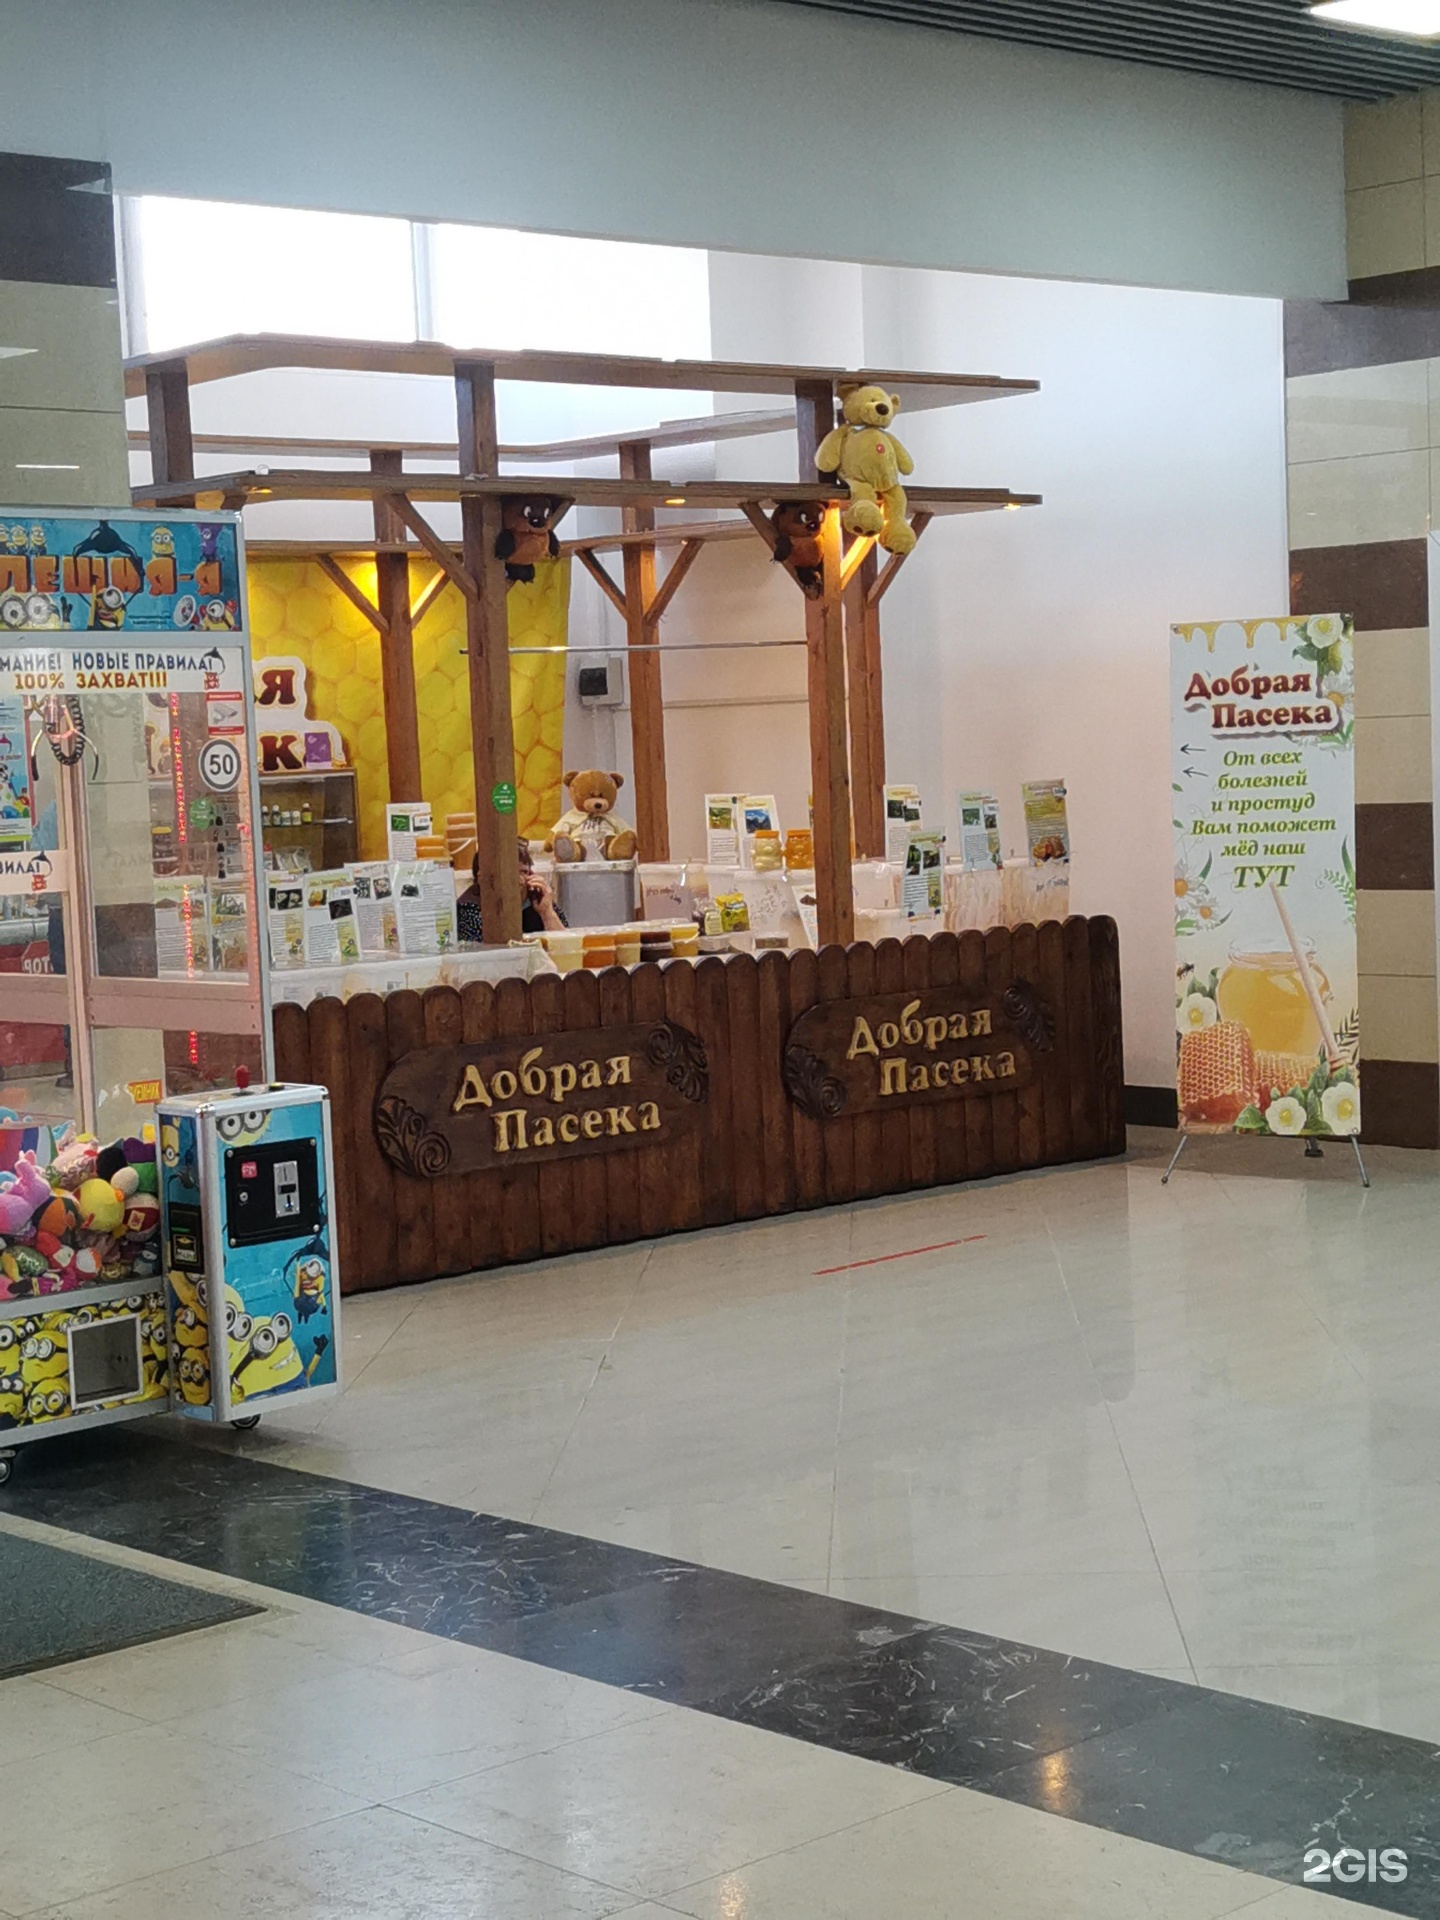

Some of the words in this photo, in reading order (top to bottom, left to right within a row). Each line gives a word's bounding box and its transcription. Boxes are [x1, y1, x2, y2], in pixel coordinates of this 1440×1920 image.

[72, 652, 130, 671] НОВЫЕ
[135, 653, 213, 671] ПРАВИЛА!
[15, 673, 65, 690] 100%
[76, 672, 168, 690] ЗАХВАТ!!!
[1184, 665, 1312, 701] Добрая
[1210, 703, 1333, 729] Пасека
[209, 753, 234, 776] 50
[1223, 750, 1255, 767] От
[1259, 750, 1303, 765] всех
[1217, 770, 1309, 790] болезней
[1210, 800, 1223, 812] и
[1227, 793, 1317, 815] простуд
[1191, 819, 1232, 836] Вам
[1236, 818, 1336, 834] поможет
[1220, 840, 1259, 857] мёд
[1262, 842, 1306, 857] наш
[1233, 865, 1296, 889] ТУТ
[847, 999, 993, 1060] Добрая
[452, 1046, 633, 1113] Добрая
[879, 1050, 1017, 1096] Пасека
[491, 1099, 662, 1153] Пасека
